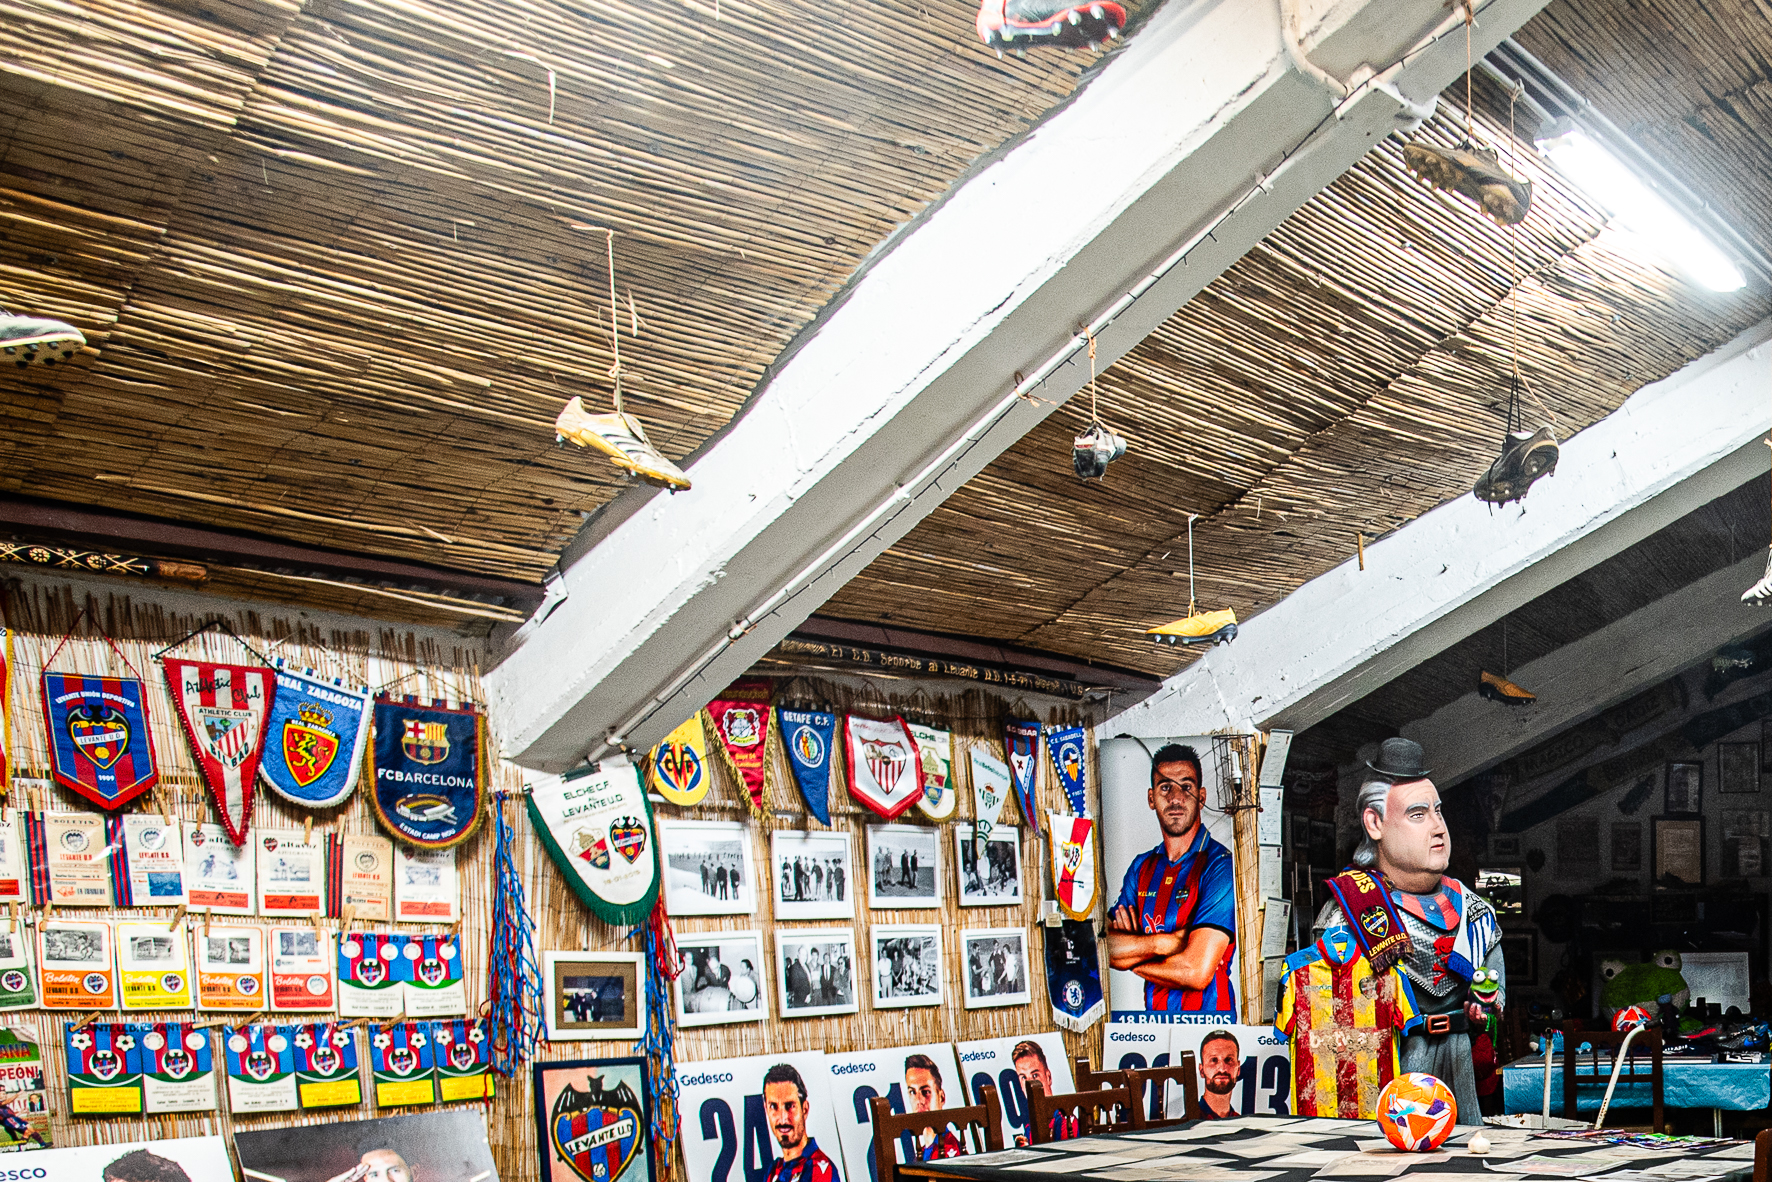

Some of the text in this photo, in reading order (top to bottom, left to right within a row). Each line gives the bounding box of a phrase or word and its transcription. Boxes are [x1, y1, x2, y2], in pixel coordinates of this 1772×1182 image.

[277, 674, 363, 711] REAL ZARAGOZA
[199, 708, 231, 717] ATHLETIC
[783, 711, 811, 724] GETAFE
[210, 742, 250, 768] BILBAO
[563, 786, 595, 800] ELCHE
[562, 798, 606, 818] LEVANTE
[1368, 937, 1395, 957] LEVANTE
[1118, 1014, 1231, 1025] 18 BALLESTEROS
[1110, 1031, 1156, 1042] Gedesco
[831, 1062, 876, 1075] Gedesco
[680, 1072, 733, 1087] Gedesco
[1237, 1055, 1291, 1115] 13
[569, 1127, 616, 1152] LEVANTE
